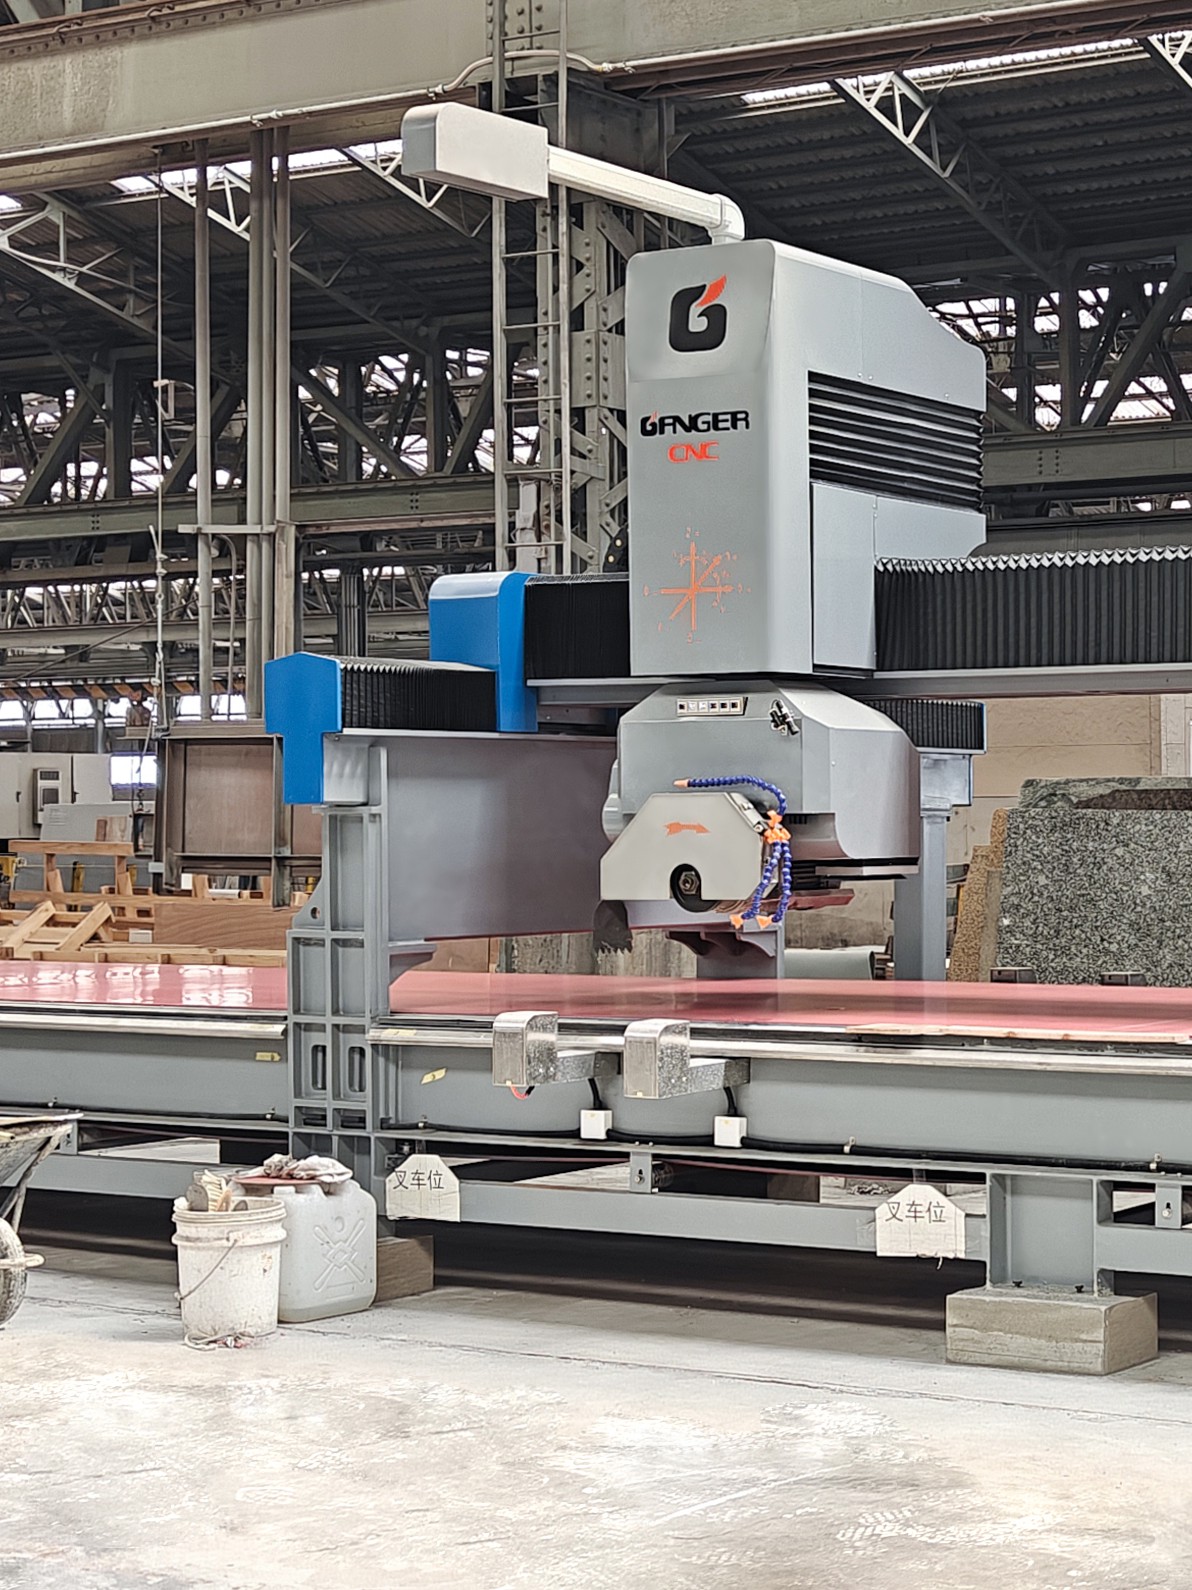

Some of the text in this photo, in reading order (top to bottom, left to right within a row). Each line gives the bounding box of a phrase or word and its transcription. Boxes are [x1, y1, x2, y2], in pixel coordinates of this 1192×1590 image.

[640, 411, 750, 436] GANGER
[668, 441, 719, 463] CNC
[393, 1169, 444, 1190] 叉车位
[885, 1200, 946, 1224] 叉车位
